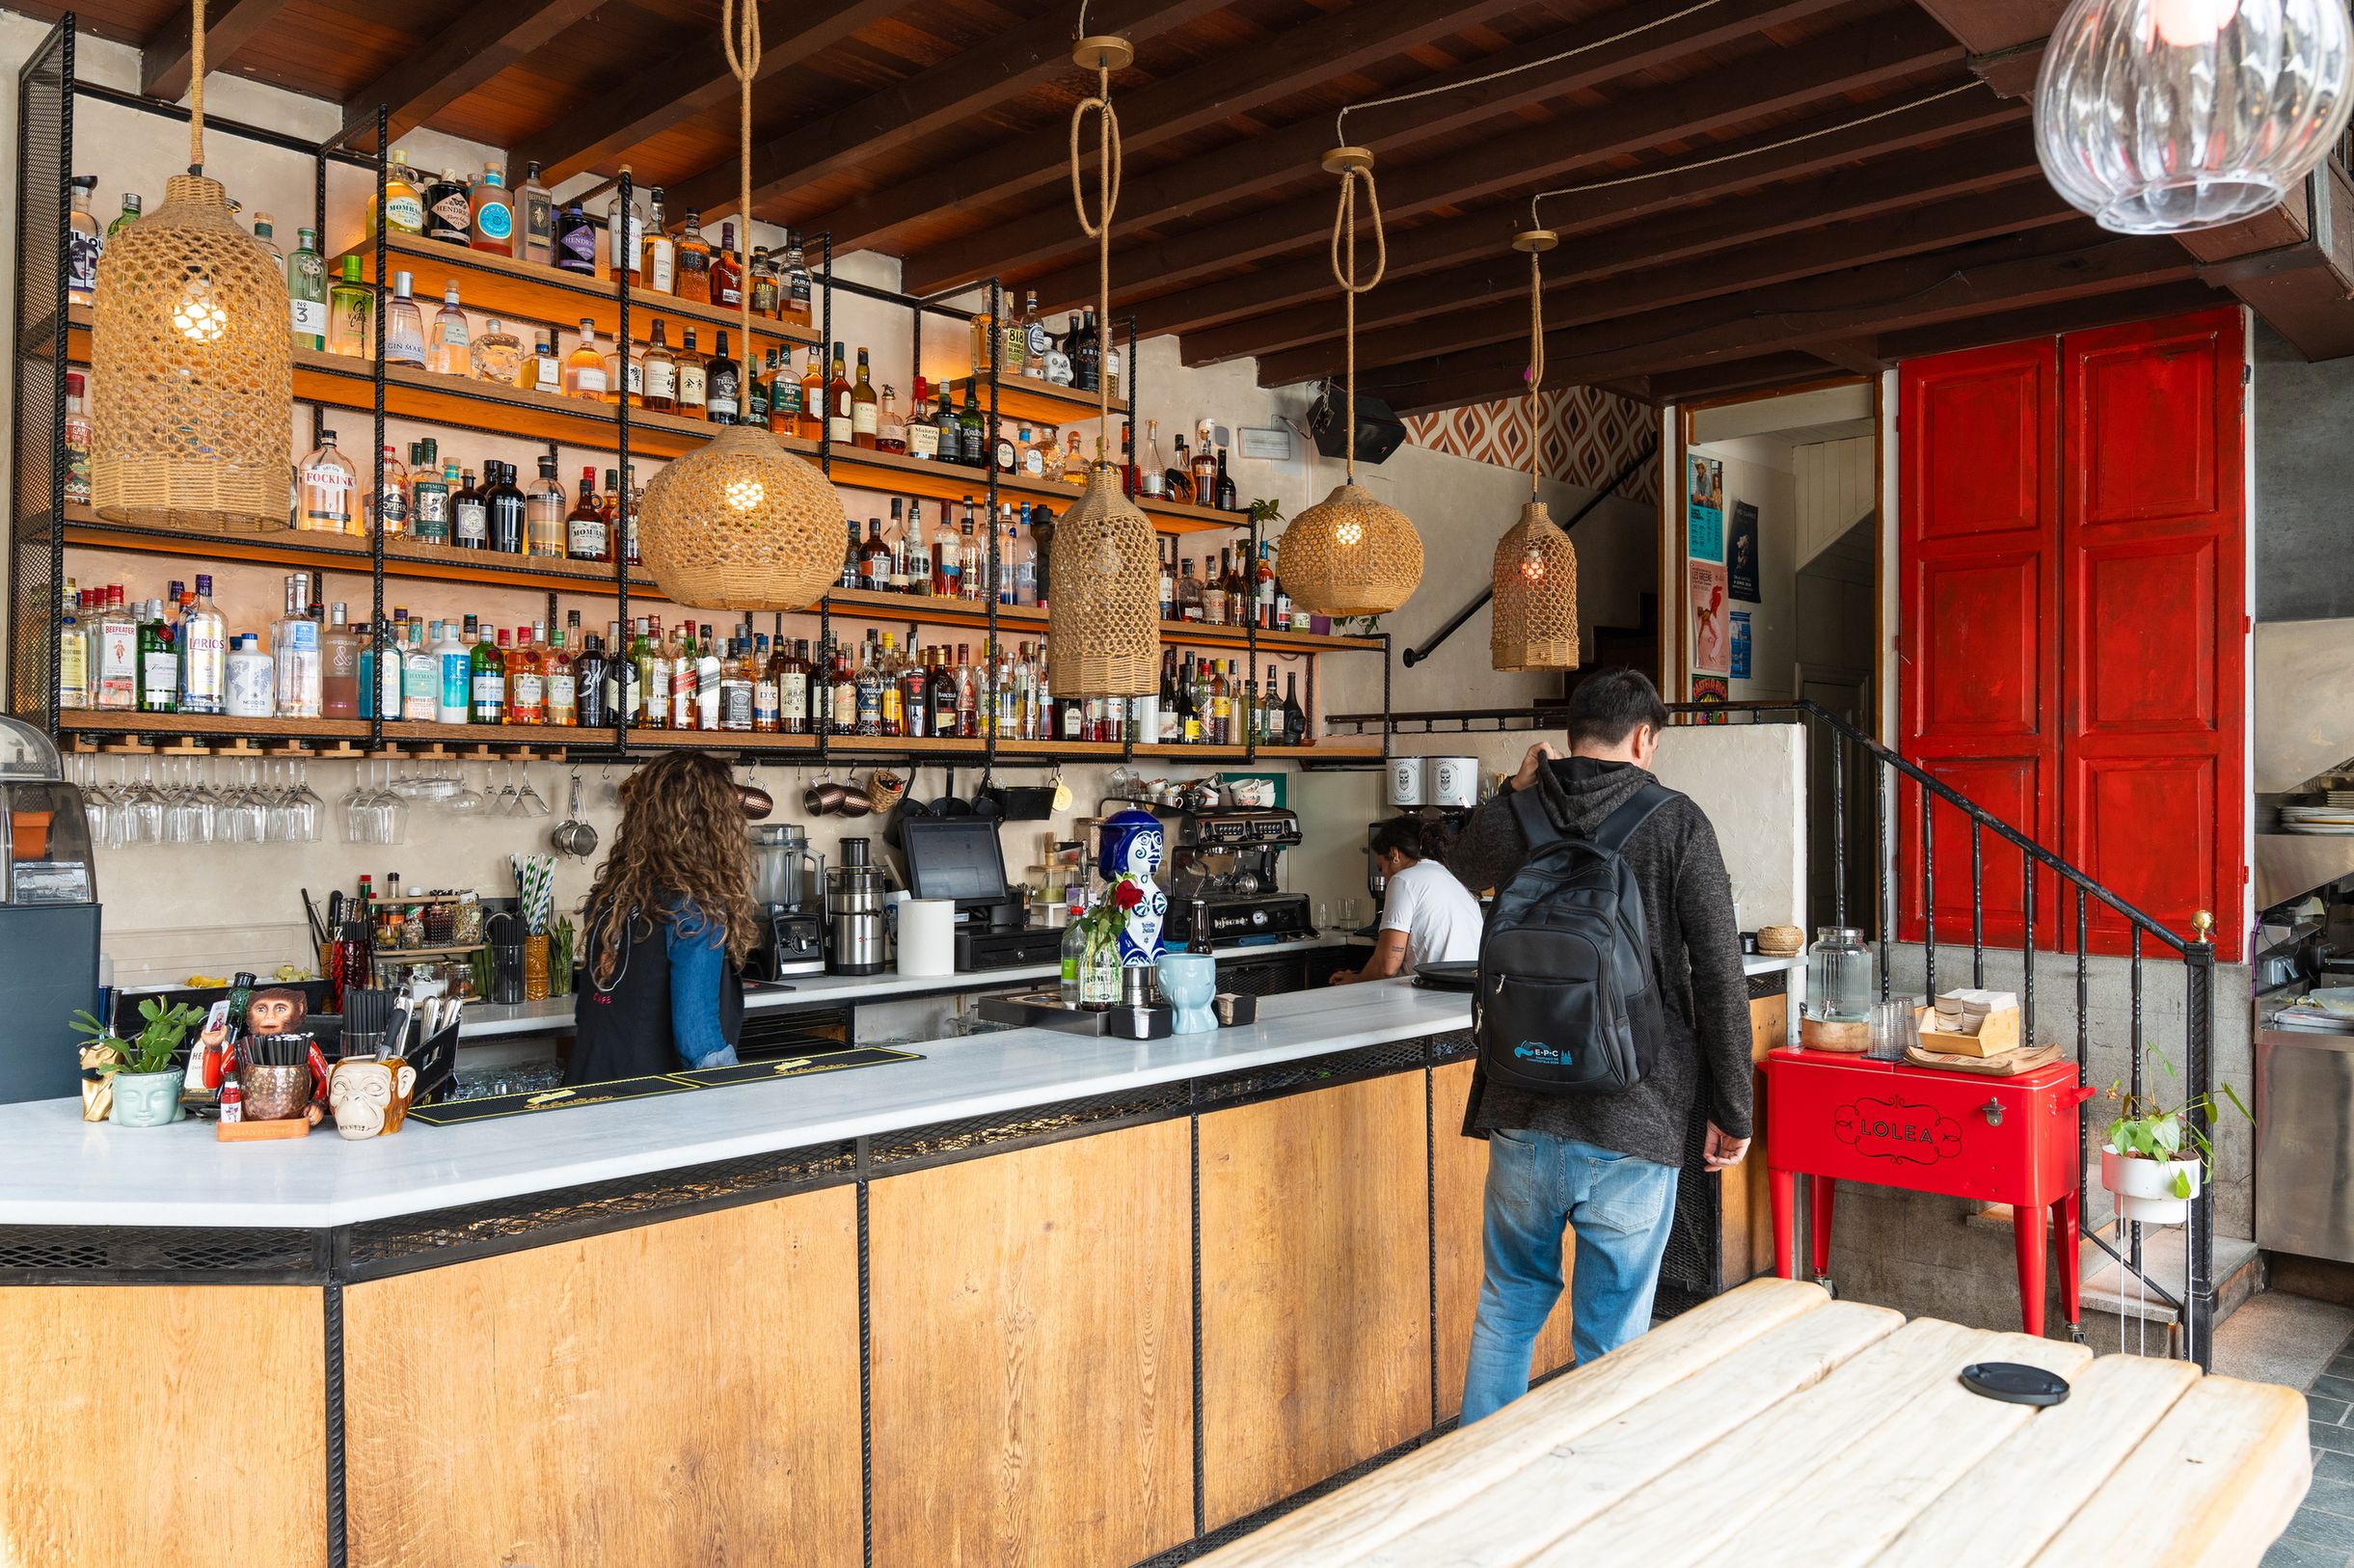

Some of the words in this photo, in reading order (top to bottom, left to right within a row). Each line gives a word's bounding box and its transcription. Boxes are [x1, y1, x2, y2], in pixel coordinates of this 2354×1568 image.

[792, 278, 810, 287] JURA
[296, 307, 309, 323] 3
[1008, 329, 1024, 344] 818
[915, 426, 938, 436] Maker's
[941, 426, 949, 435] 10
[307, 472, 354, 487] FOCKINK
[105, 626, 135, 635] BEEFEATER
[189, 637, 225, 651] LARIOS
[457, 660, 466, 676] F
[1860, 1119, 1933, 1145] LOLEA
